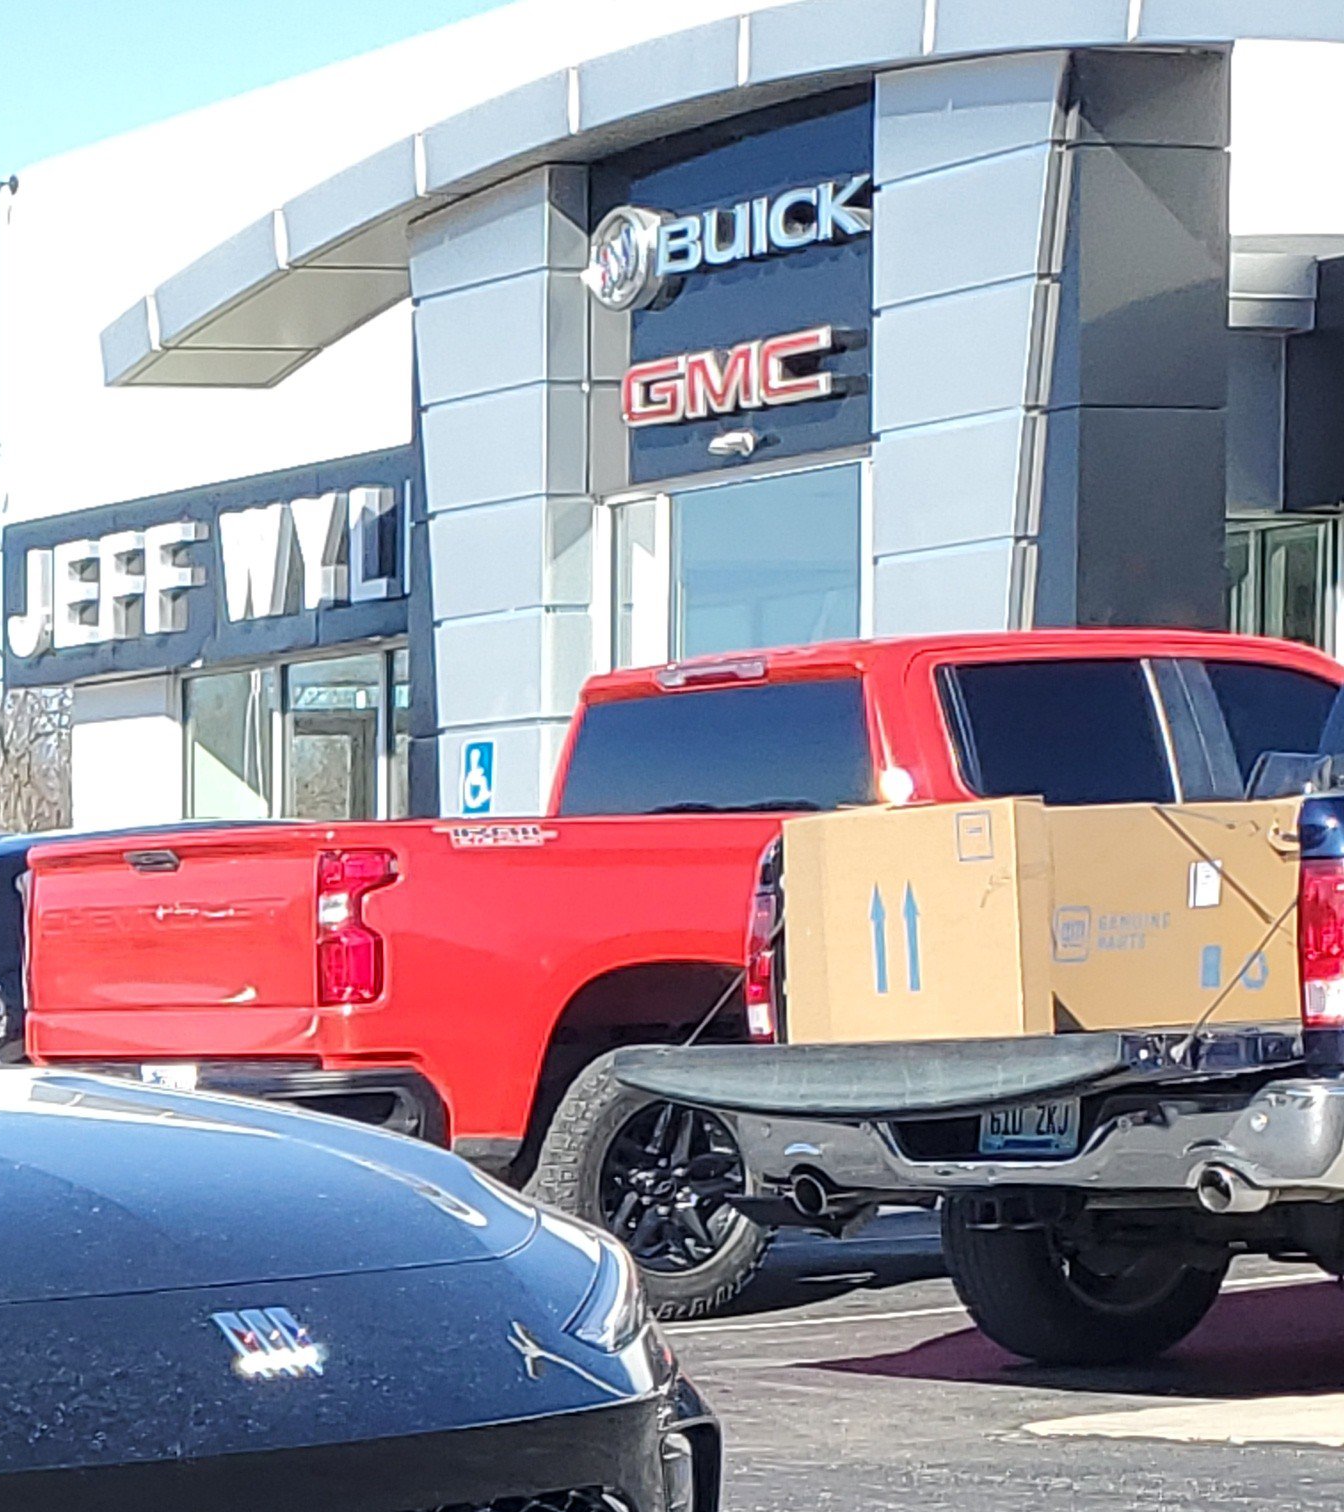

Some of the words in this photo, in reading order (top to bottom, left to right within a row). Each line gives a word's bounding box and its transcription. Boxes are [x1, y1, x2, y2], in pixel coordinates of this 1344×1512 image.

[655, 173, 871, 277] BUICK
[621, 325, 832, 427] GMC
[7, 521, 210, 659] JEFF
[218, 479, 412, 623] WYL
